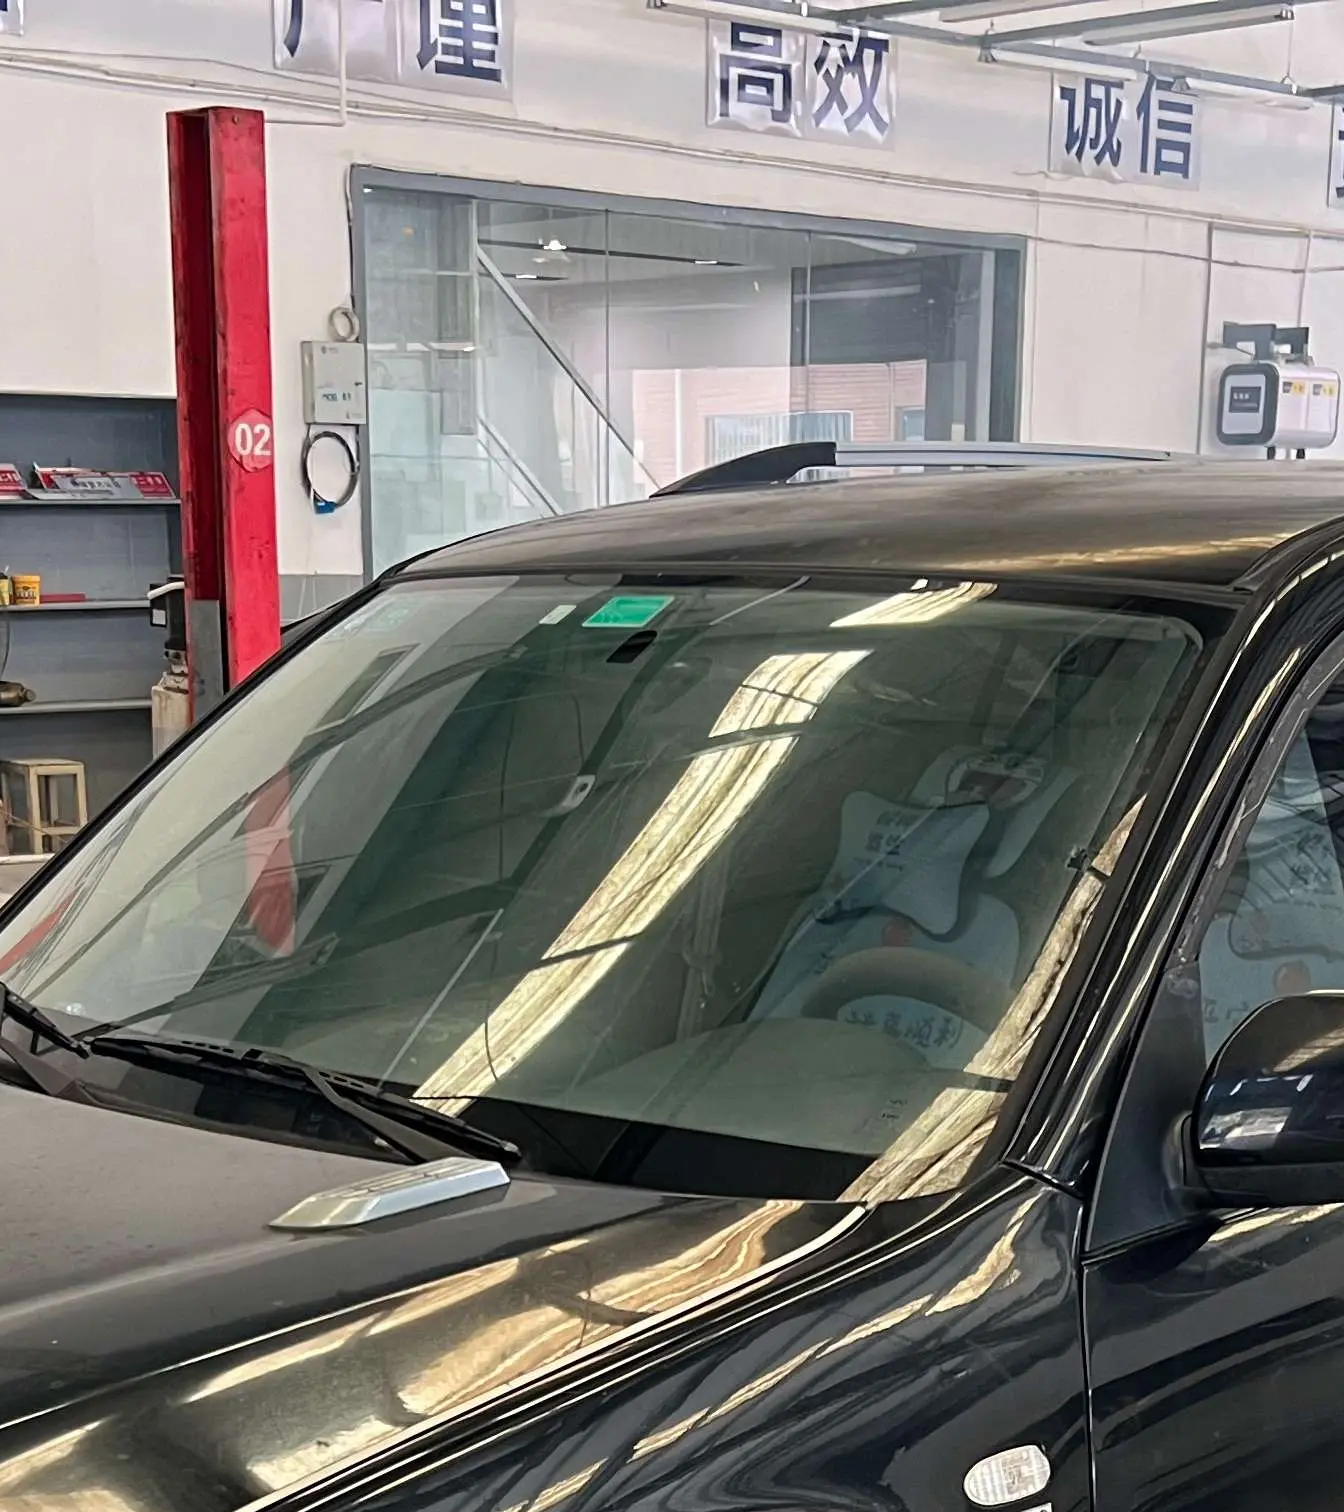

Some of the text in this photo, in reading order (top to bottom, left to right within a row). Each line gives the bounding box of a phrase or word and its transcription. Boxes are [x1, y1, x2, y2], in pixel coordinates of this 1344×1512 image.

[719, 21, 890, 135] 高效
[1059, 71, 1194, 180] 诚信
[234, 423, 272, 456] 02
